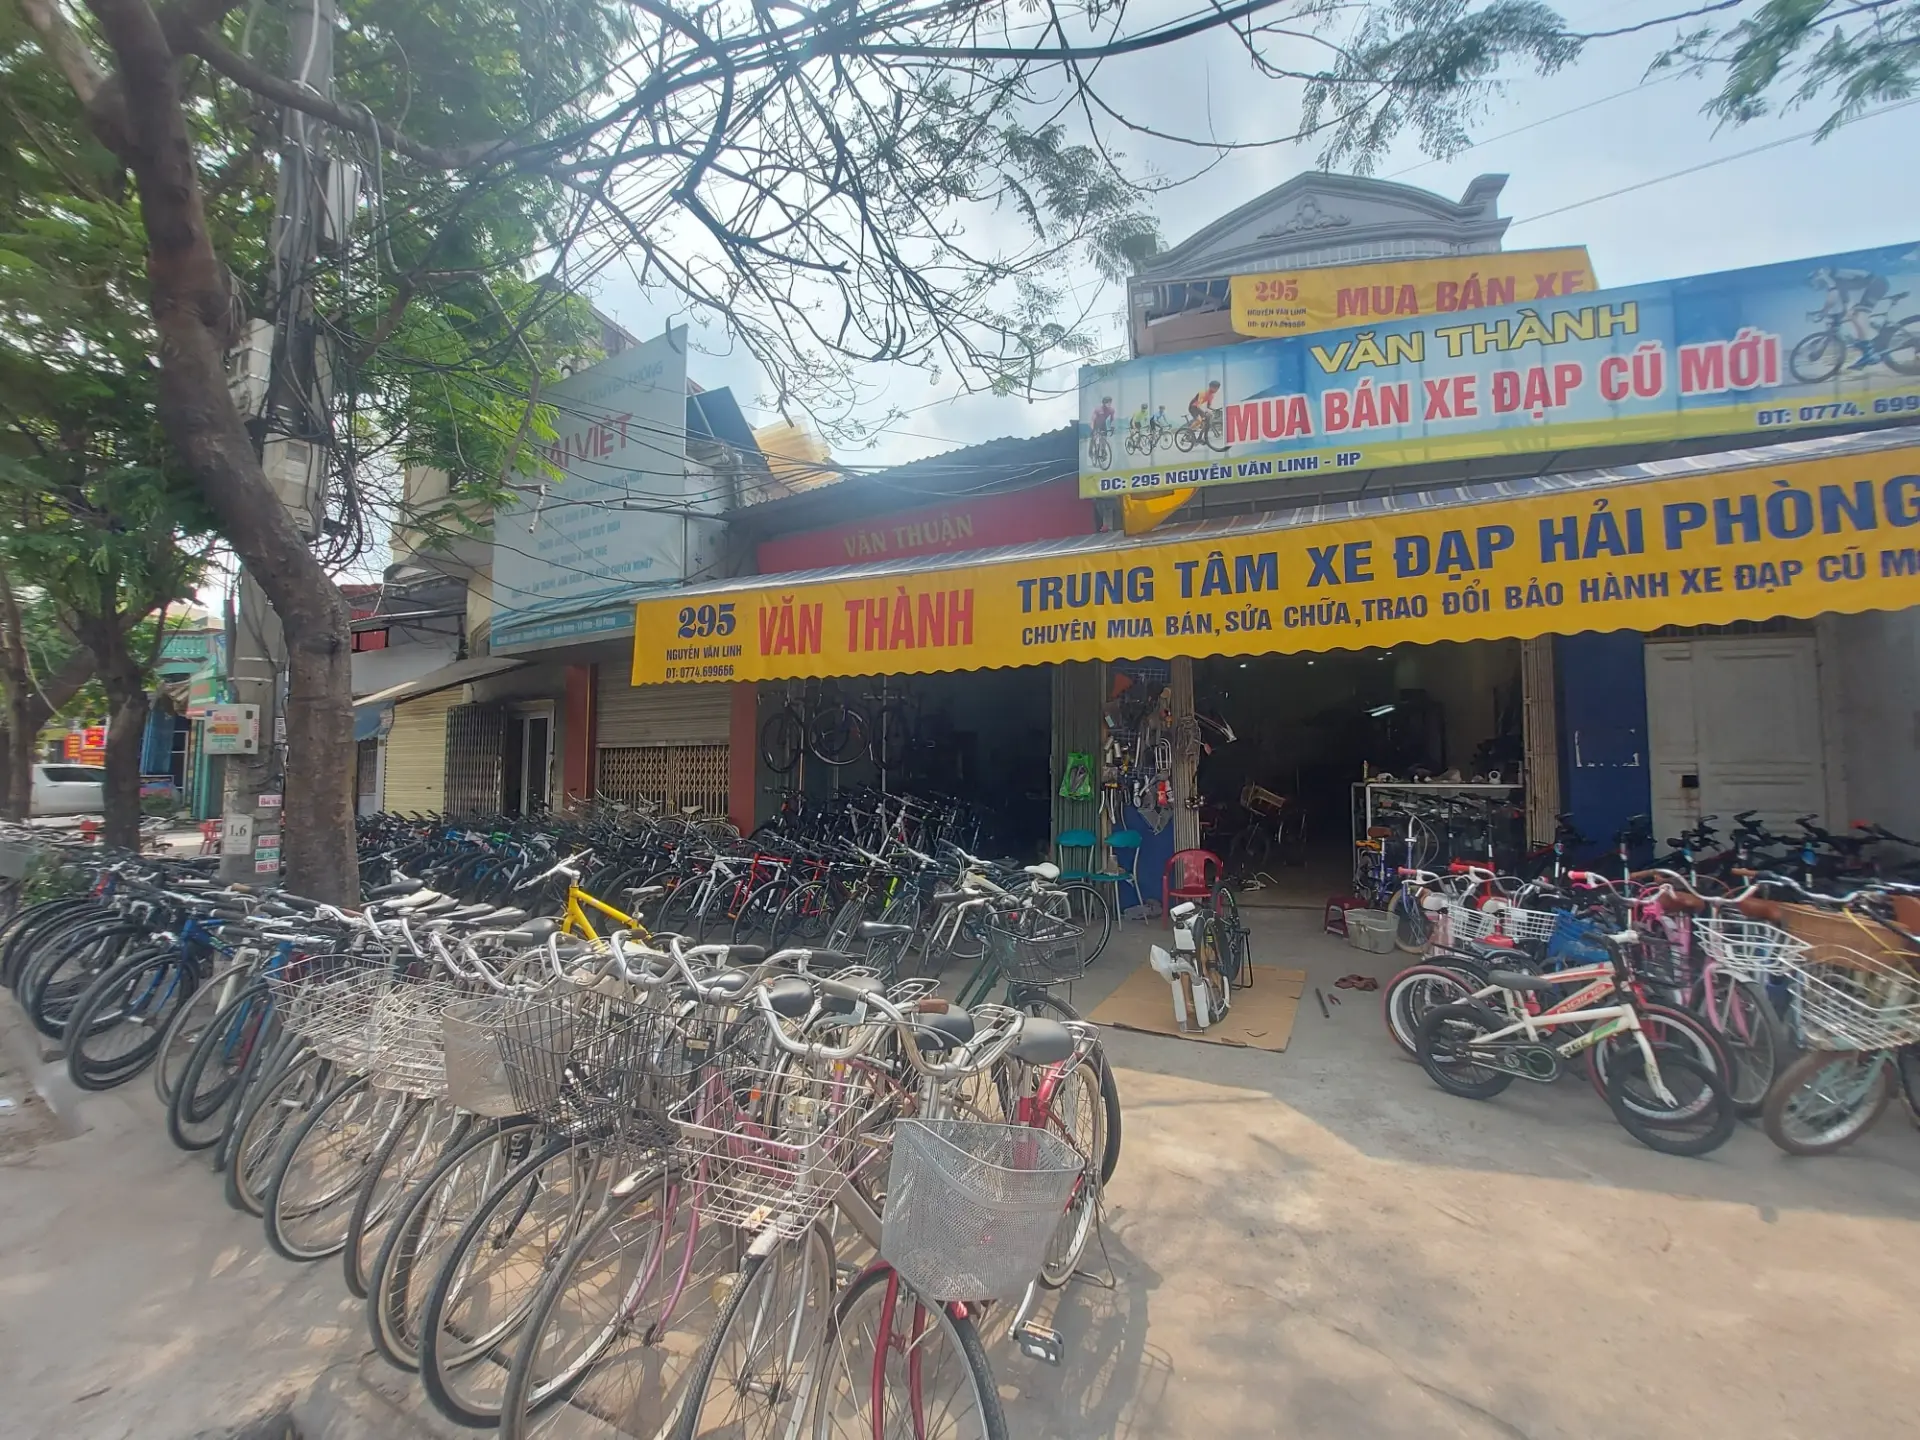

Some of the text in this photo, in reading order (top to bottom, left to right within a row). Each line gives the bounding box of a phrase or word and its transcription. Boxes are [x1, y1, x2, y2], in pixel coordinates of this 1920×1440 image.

[1255, 269, 1586, 318] 295 MUA BÁN XE
[1310, 301, 1639, 375] VĂN THÀNH
[1226, 330, 1777, 444] MUA BÁN XE ĐẠP CŨ MỚI
[574, 412, 633, 463] VIỆT
[1758, 409, 1790, 425] ĐT:
[1101, 479, 1126, 491] ĐC:
[1131, 473, 1160, 488] 295
[1165, 463, 1232, 485] NGUYỄN
[1237, 459, 1272, 477] VĂN
[1278, 457, 1318, 472] LINH
[1337, 452, 1361, 467] HP
[844, 511, 973, 558] VĂN THUẬN
[1017, 475, 1920, 613] TRUNG TÂM XE ĐẠP HẢI PHÒNG
[677, 602, 737, 639] 295
[1022, 619, 1096, 646] CHUYÊN
[1107, 617, 1153, 639] MUA
[1442, 578, 1490, 616] ĐỔI
[1505, 577, 1563, 610] BẢO
[1580, 572, 1669, 603] HÀNH
[1680, 566, 1723, 595] XE
[1734, 559, 1804, 593] ĐẠP
[1818, 545, 1866, 582] CŨ
[758, 586, 974, 656] VĂN THÀNH
[723, 645, 742, 657] LINH
